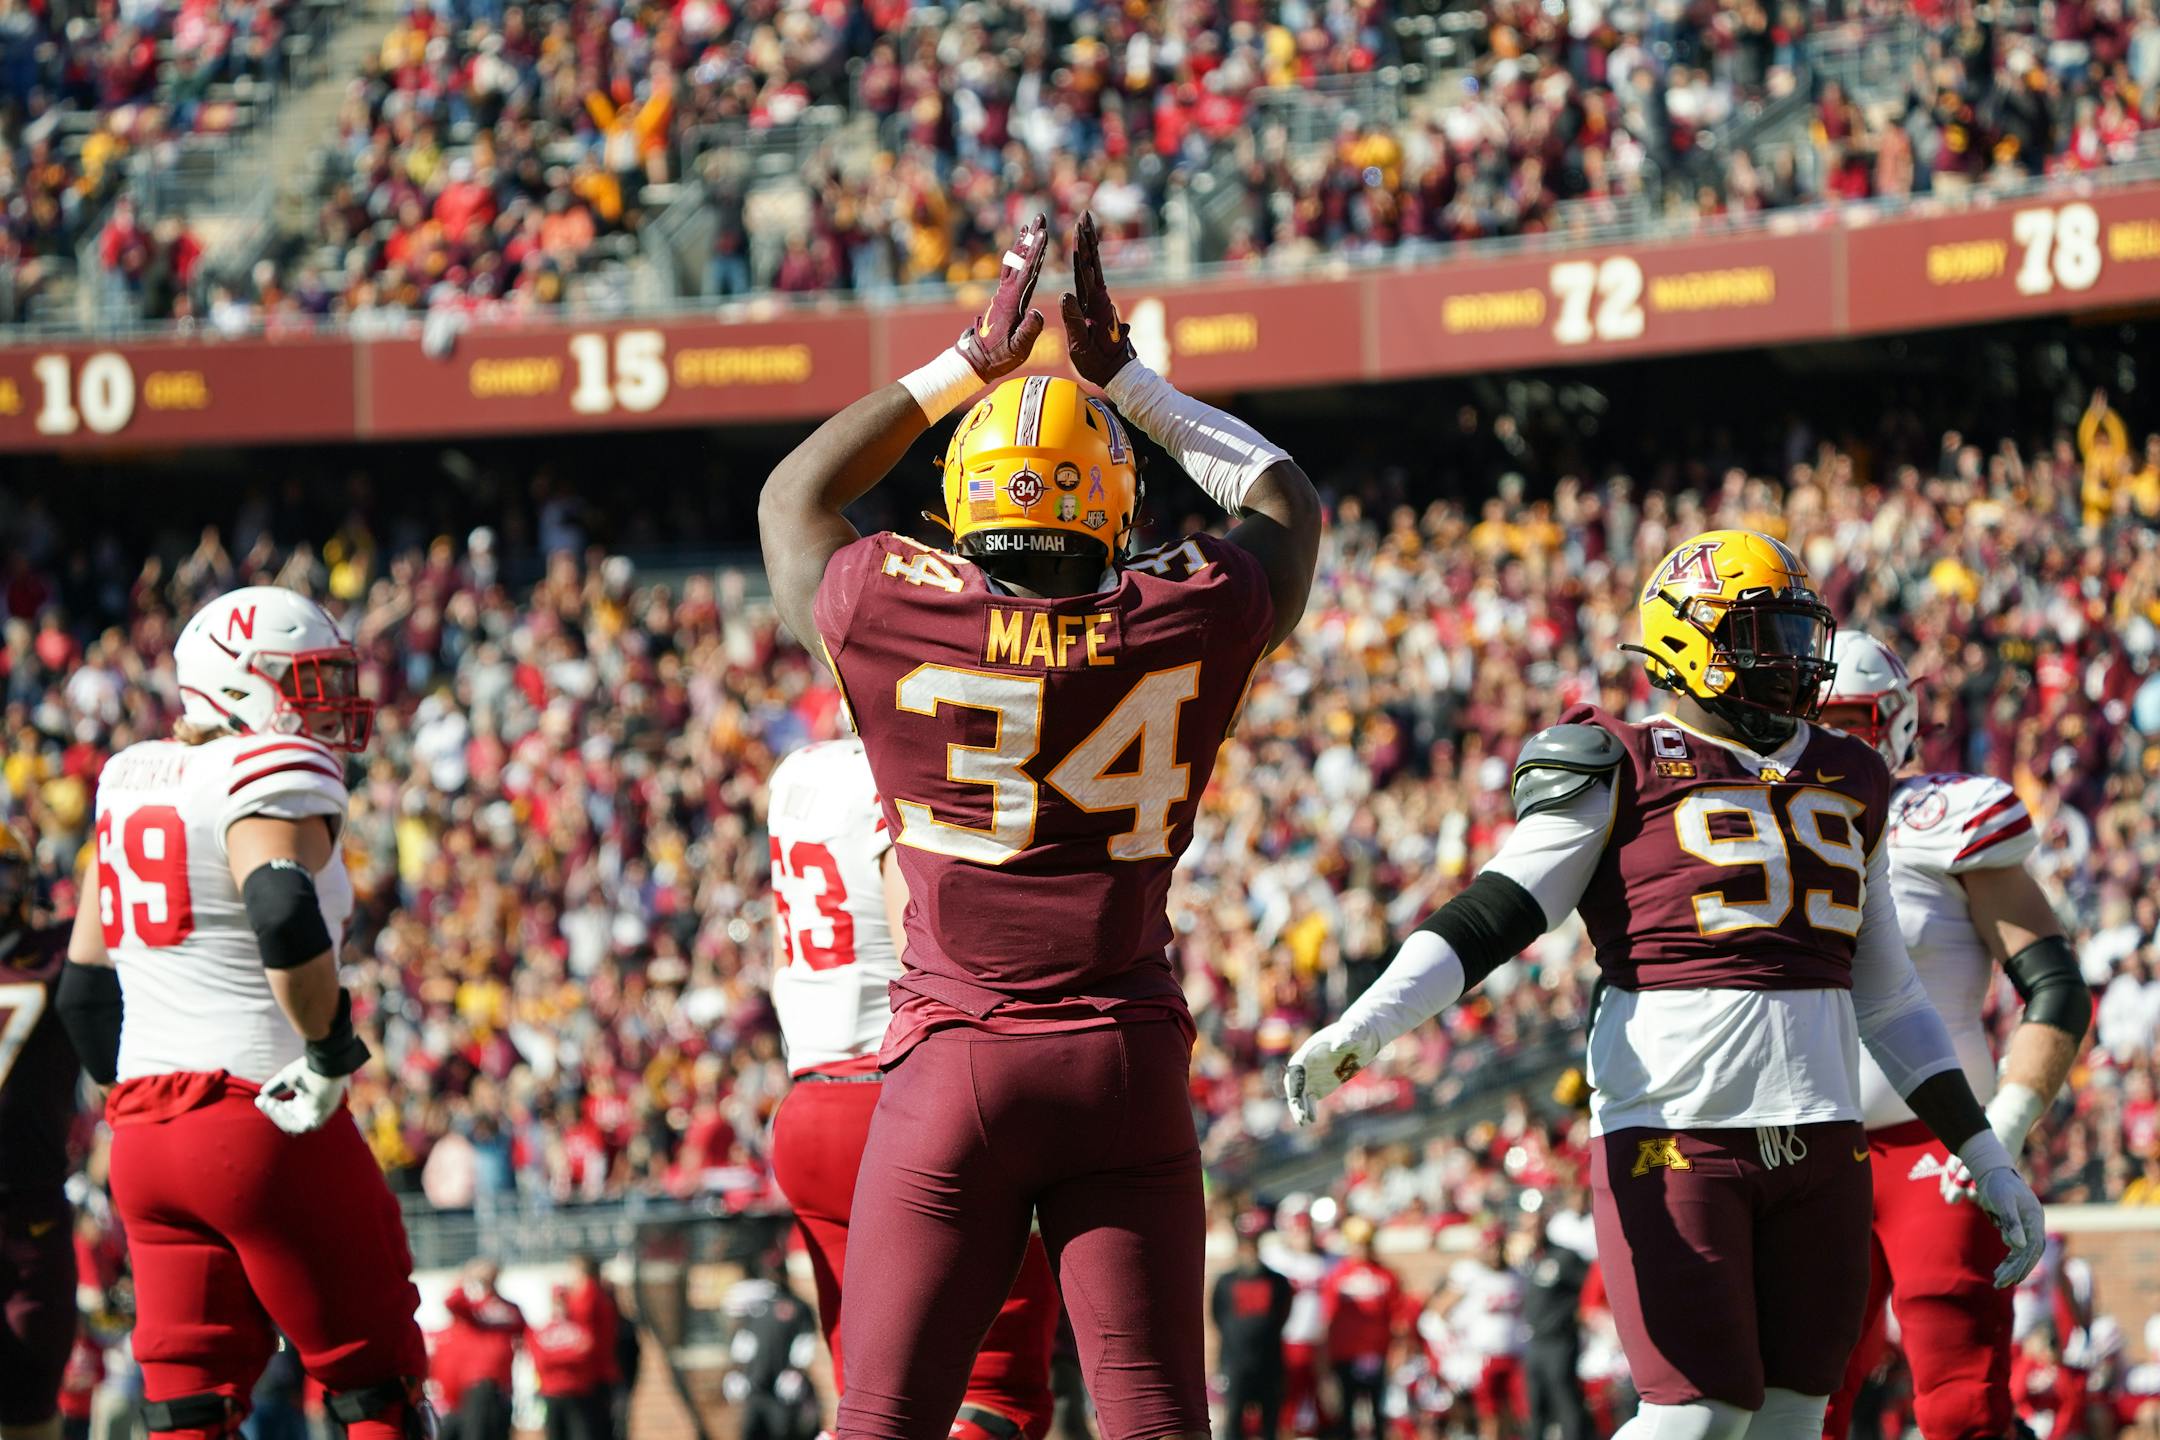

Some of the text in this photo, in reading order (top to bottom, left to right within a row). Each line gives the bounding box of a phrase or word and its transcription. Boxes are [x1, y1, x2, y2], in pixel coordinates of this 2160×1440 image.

[2012, 202, 2102, 296] 78
[1549, 256, 1644, 345] 72
[33, 351, 136, 435] 10
[569, 329, 669, 414] 15
[1016, 481, 1035, 497] 34
[985, 534, 1065, 551] SKI-U-MAH
[227, 605, 256, 641] N
[986, 609, 1116, 666] MAFE
[895, 660, 1202, 865] 34
[1653, 729, 1687, 757] C
[96, 805, 195, 948] 69
[1674, 785, 1867, 937] 99
[1631, 1136, 1691, 1178] M
